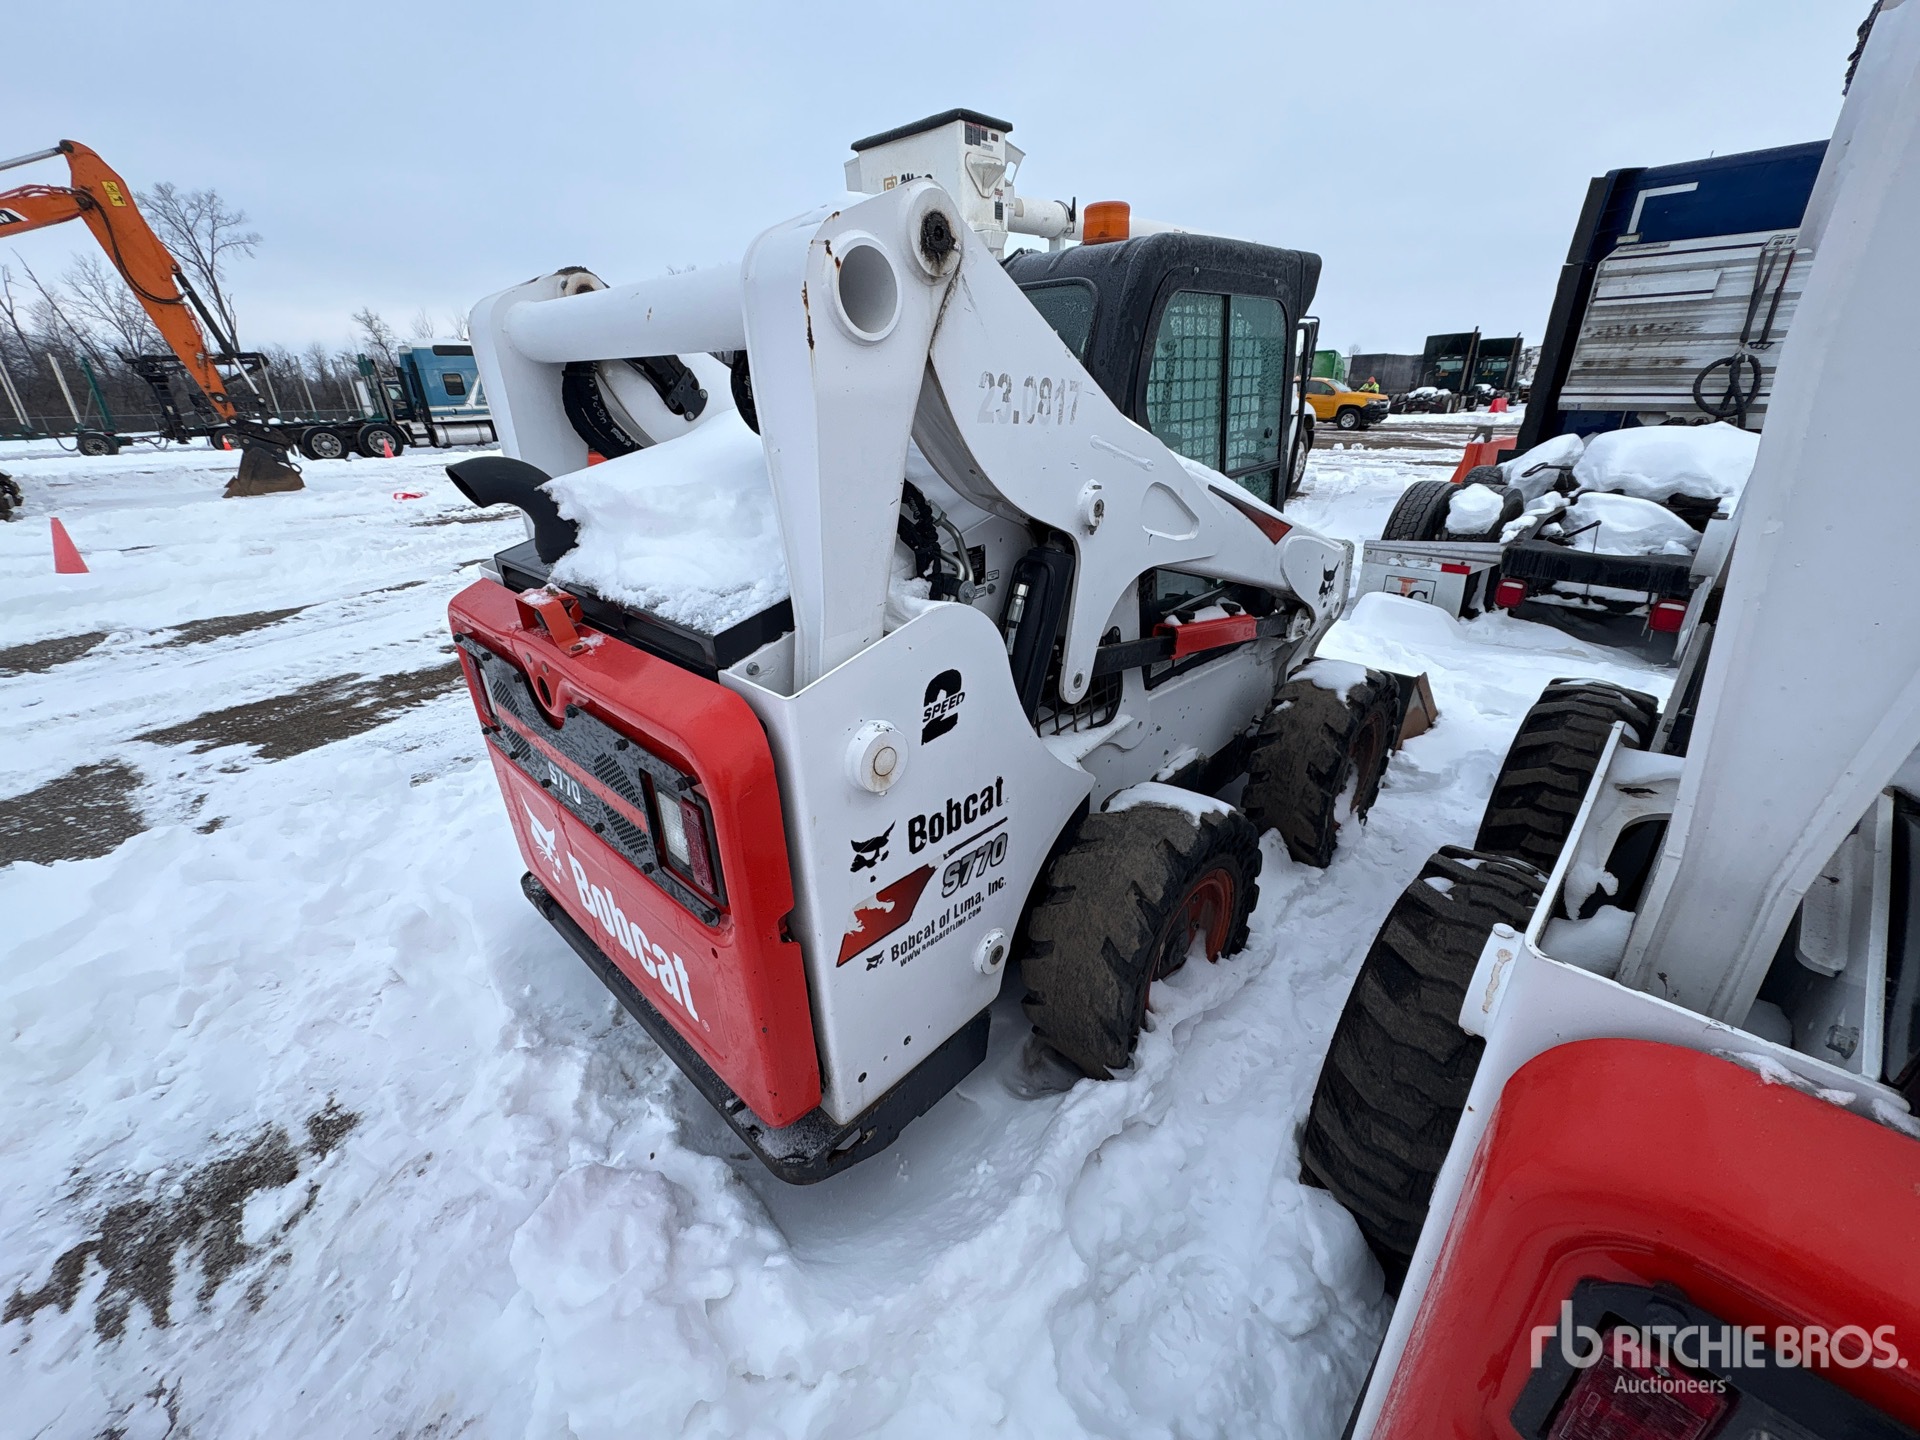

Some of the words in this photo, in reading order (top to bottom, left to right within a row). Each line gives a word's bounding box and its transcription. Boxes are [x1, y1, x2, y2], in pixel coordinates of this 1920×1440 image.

[922, 692, 966, 723] SPEED
[547, 760, 582, 806] S770
[907, 775, 1004, 855] Bobcat
[941, 832, 1009, 899] S770
[566, 850, 700, 1023] Bobcat
[890, 919, 936, 963] Bobcat
[938, 908, 951, 929] of
[953, 891, 985, 919] Lima,
[988, 876, 1007, 897] Inc.
